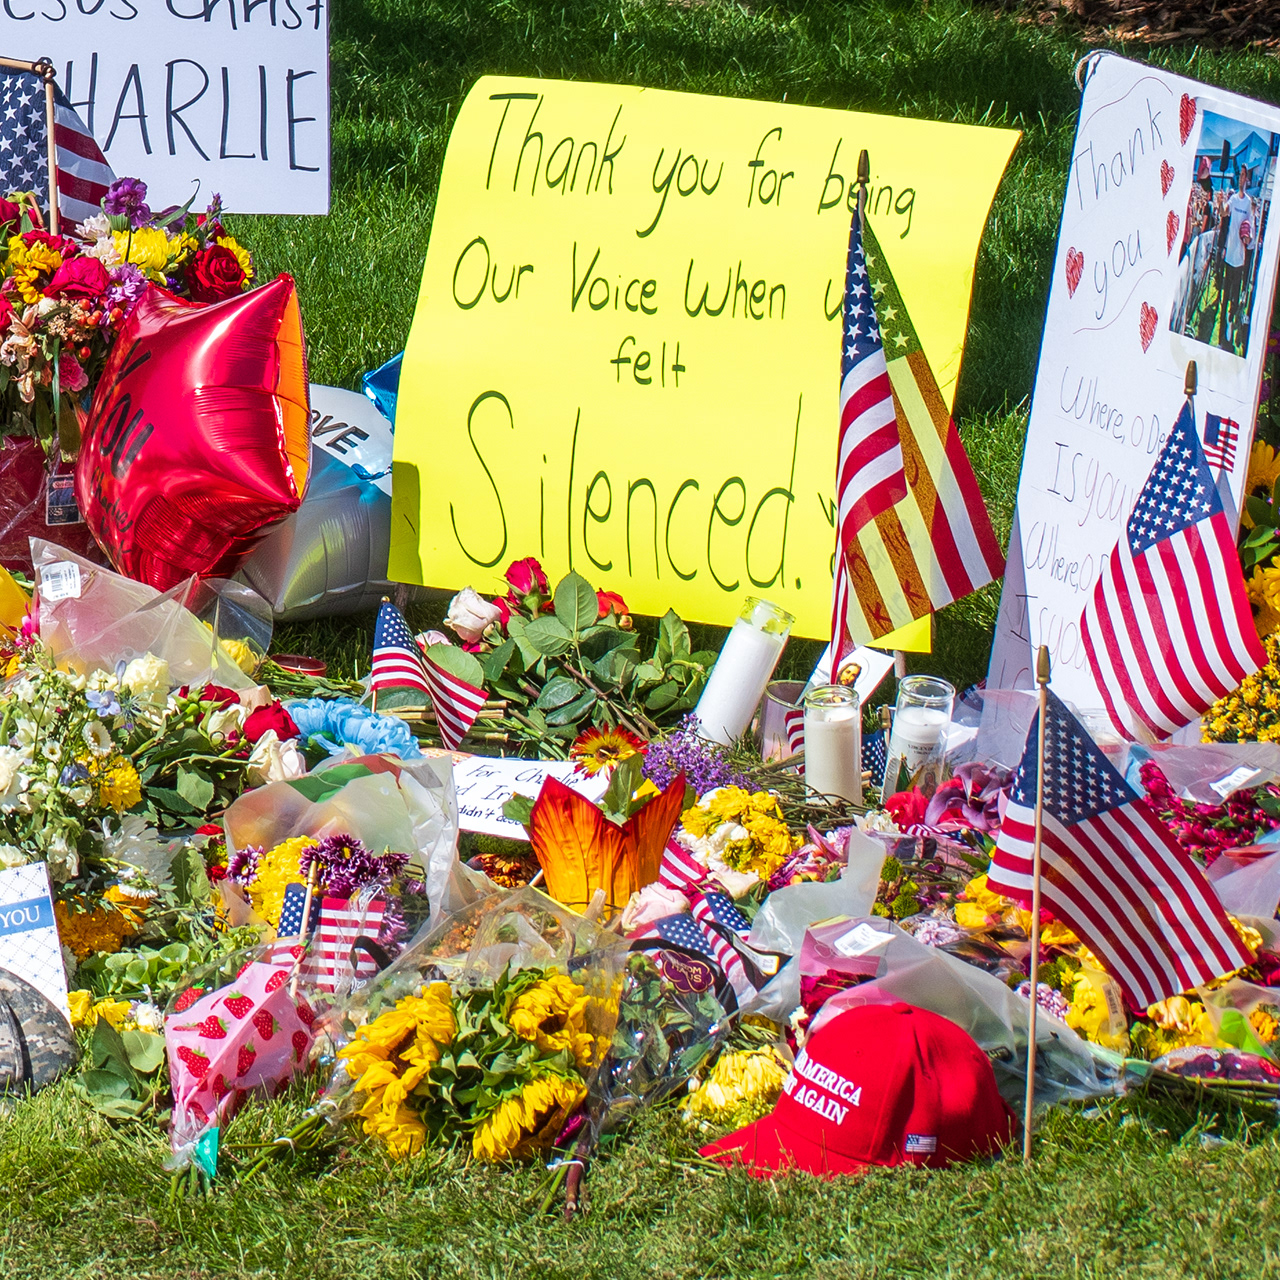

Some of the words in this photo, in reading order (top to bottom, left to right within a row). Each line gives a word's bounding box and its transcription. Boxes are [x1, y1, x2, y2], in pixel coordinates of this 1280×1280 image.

[64, 52, 321, 173] HARLIE
[1070, 97, 1163, 211] Thank
[486, 92, 627, 197] Thank
[635, 146, 724, 239] you
[746, 127, 795, 209] for
[817, 137, 917, 241] being
[451, 235, 535, 310] Our
[570, 240, 659, 315] Voice
[1093, 229, 1142, 320] you
[609, 335, 687, 388] felt
[448, 389, 804, 592] Silenced.
[466, 764, 502, 779] For
[793, 1084, 850, 1126] AGAIN
[801, 1058, 862, 1107] AMERICA
